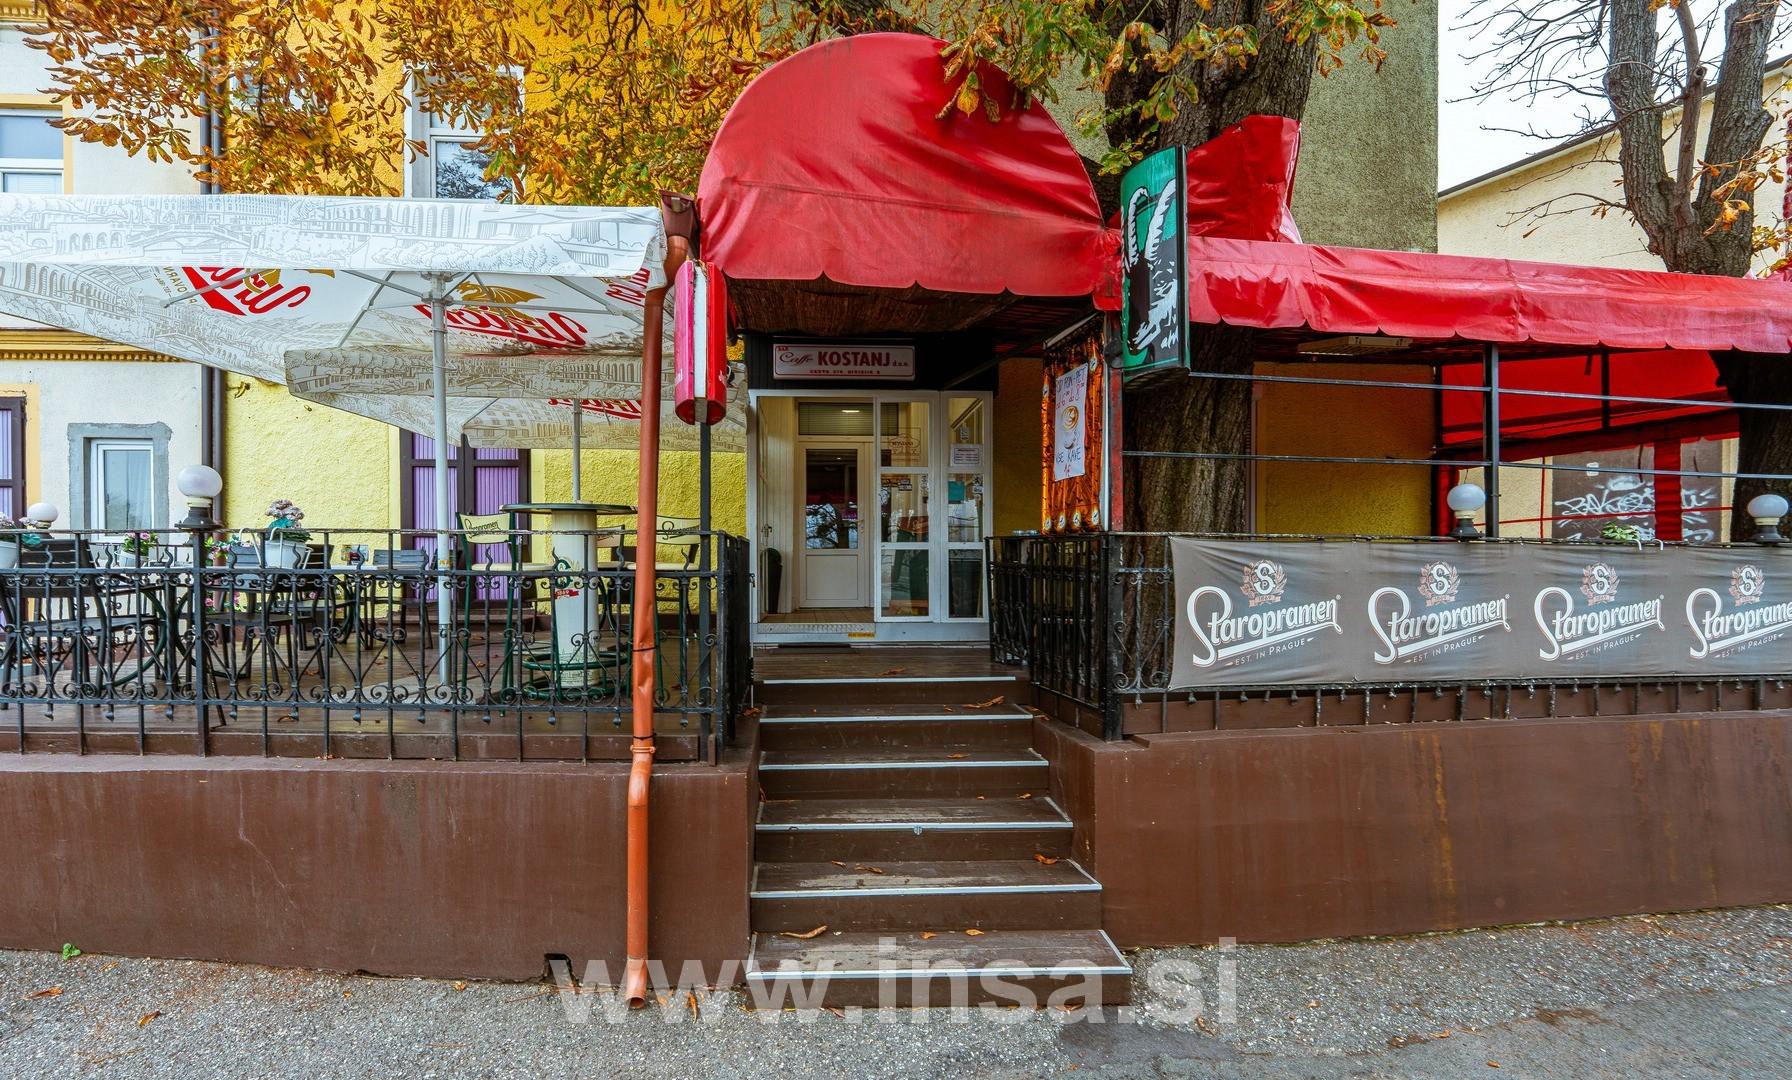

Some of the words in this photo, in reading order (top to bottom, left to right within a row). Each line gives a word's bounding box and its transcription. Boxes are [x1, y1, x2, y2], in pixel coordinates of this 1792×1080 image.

[818, 351, 890, 367] KOSTANJ
[1187, 586, 1343, 667] Staropramen
[1368, 586, 1512, 664] Staropramen
[1534, 586, 1665, 661] Staropramen
[1686, 587, 1792, 659] Staroprame
[1256, 649, 1266, 659] IN
[1269, 637, 1305, 655] PRAGUE
[1432, 648, 1441, 656] IN
[1444, 635, 1477, 653] PRAGUE
[1593, 646, 1601, 654] IN
[1603, 634, 1634, 650] PRAGUE
[1748, 633, 1777, 649] PRAGUE
